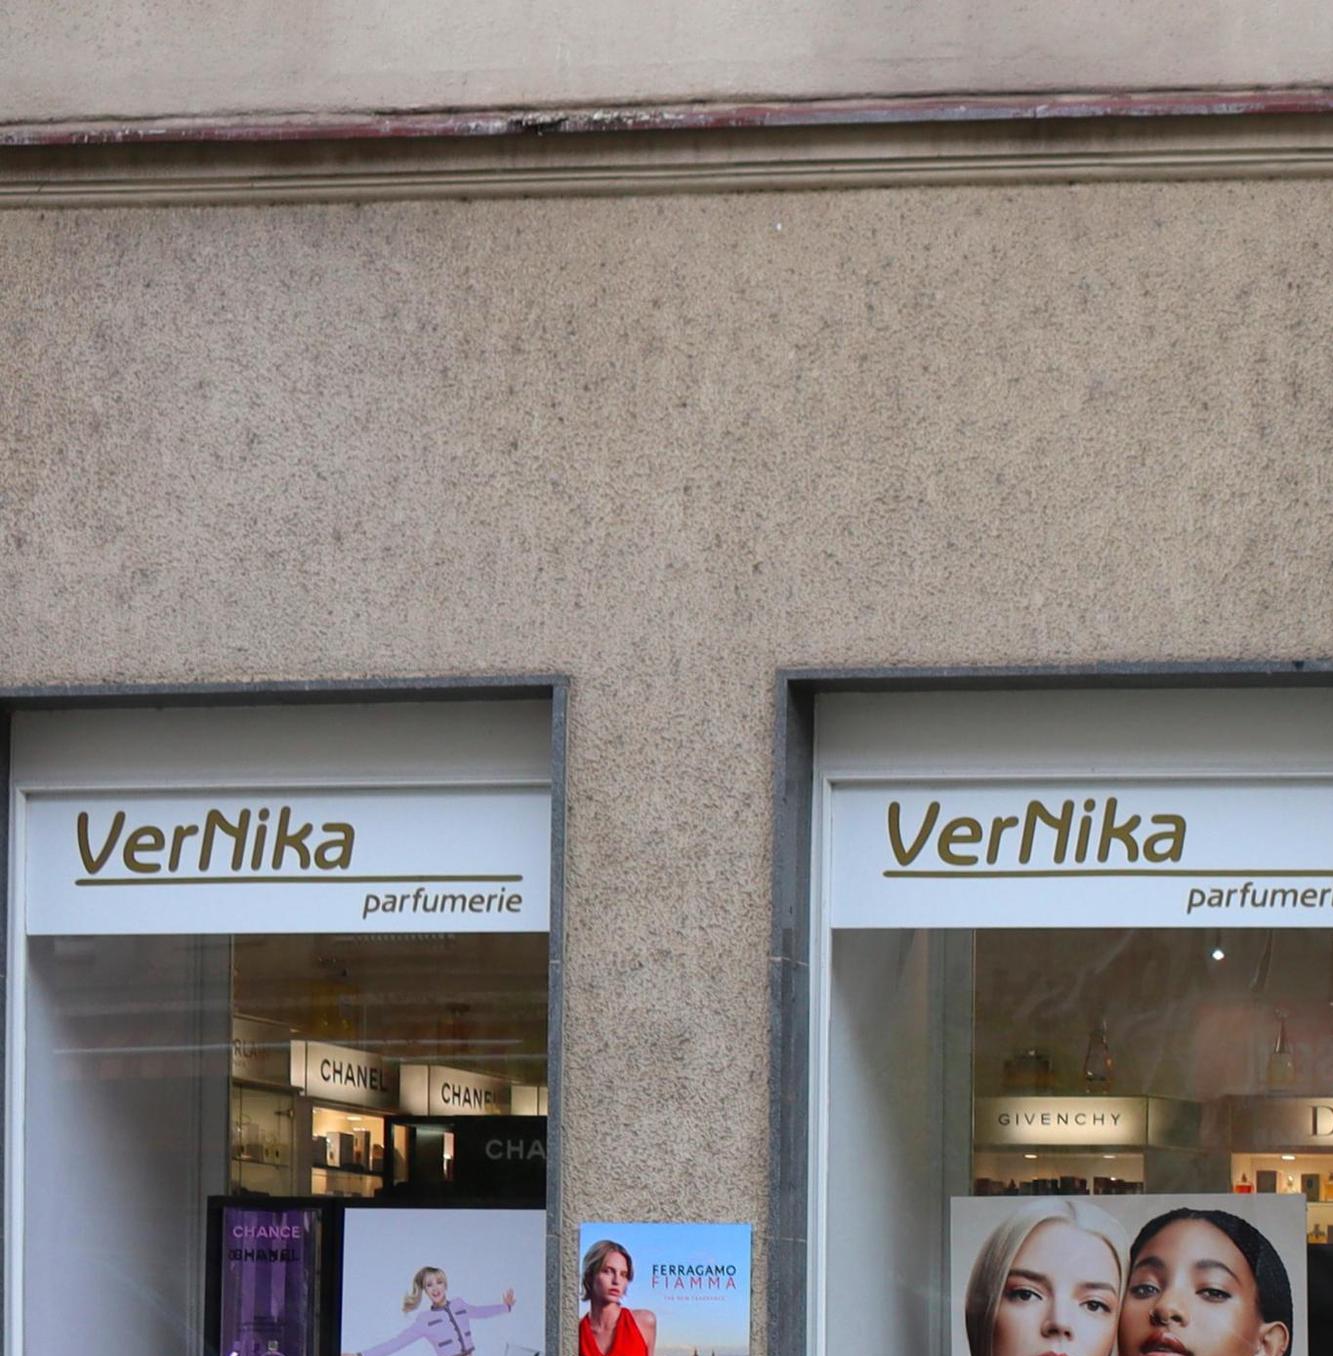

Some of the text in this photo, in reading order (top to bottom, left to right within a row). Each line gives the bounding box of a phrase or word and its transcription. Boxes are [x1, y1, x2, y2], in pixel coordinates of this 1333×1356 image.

[75, 806, 356, 875] VerNika
[886, 797, 1188, 867] VerNika
[362, 887, 524, 920] parfumerie
[319, 1058, 389, 1092] CHANEL
[997, 1112, 1123, 1127] GIVENCHY
[232, 1225, 301, 1239] CHANCE
[652, 1264, 737, 1276] FERRAGAMO
[651, 1276, 737, 1289] FIAMMA
